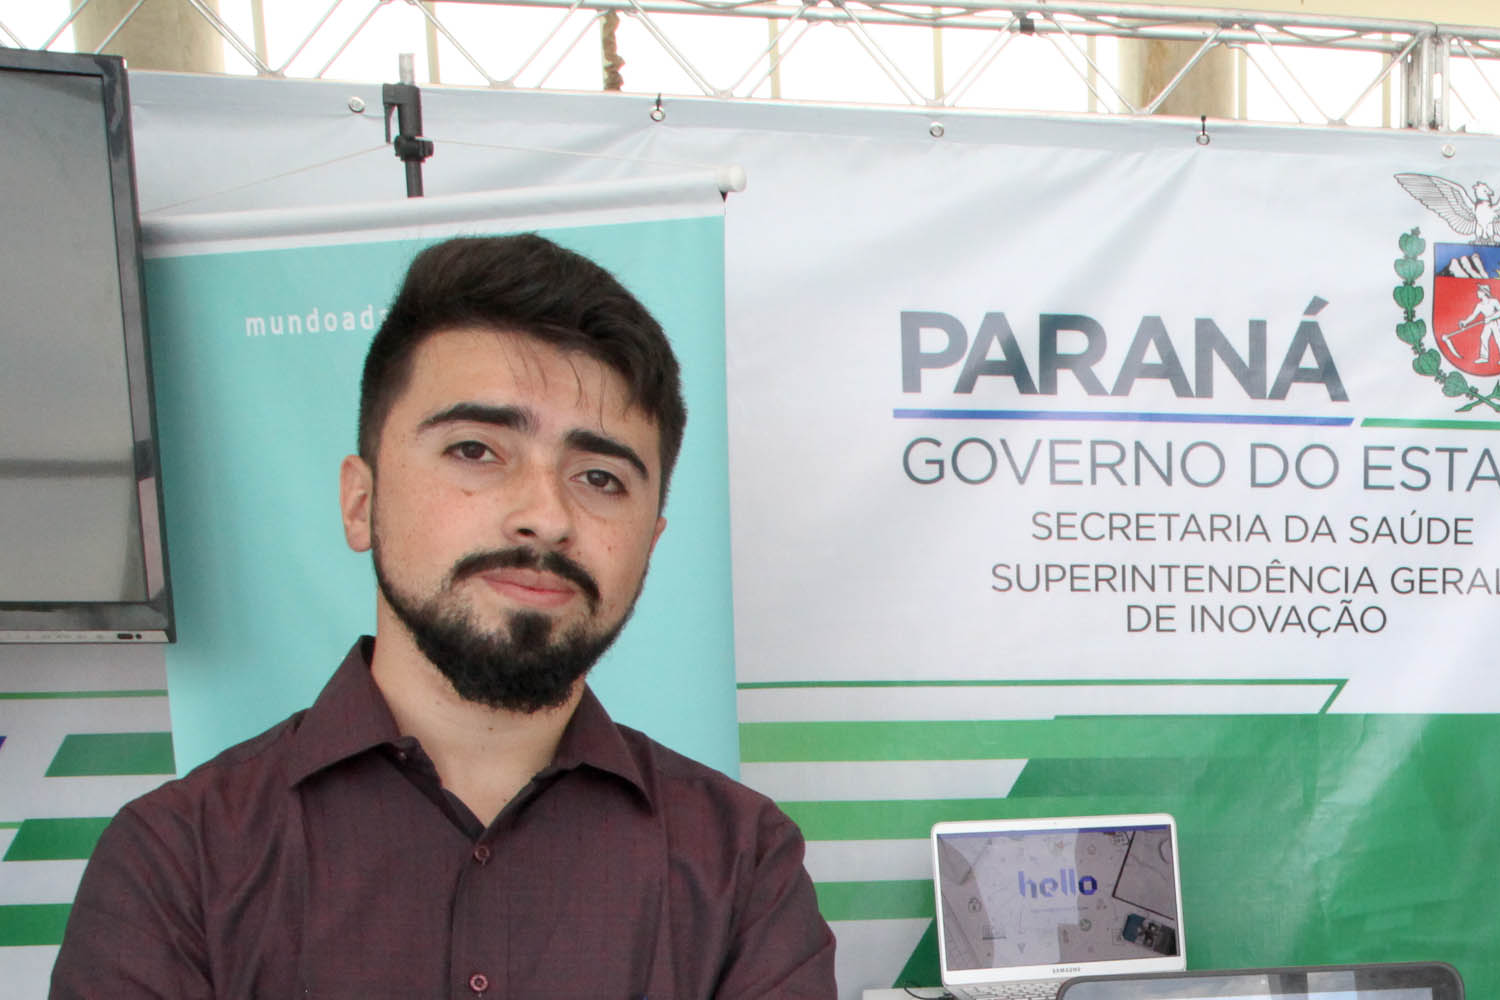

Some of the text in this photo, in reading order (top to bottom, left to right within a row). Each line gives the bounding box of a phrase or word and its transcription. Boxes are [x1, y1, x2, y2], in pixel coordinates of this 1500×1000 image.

[900, 295, 1350, 403] PARANÁ
[902, 436, 1226, 488] GOVERNO
[1250, 443, 1339, 490] DO
[1032, 509, 1474, 546] SECRETARIA DA SAÚDE
[991, 557, 1379, 595] SUPERINTENDÊNCIA
[1126, 599, 1388, 639] DE INOVAÇÃO
[1017, 868, 1099, 898] hello
